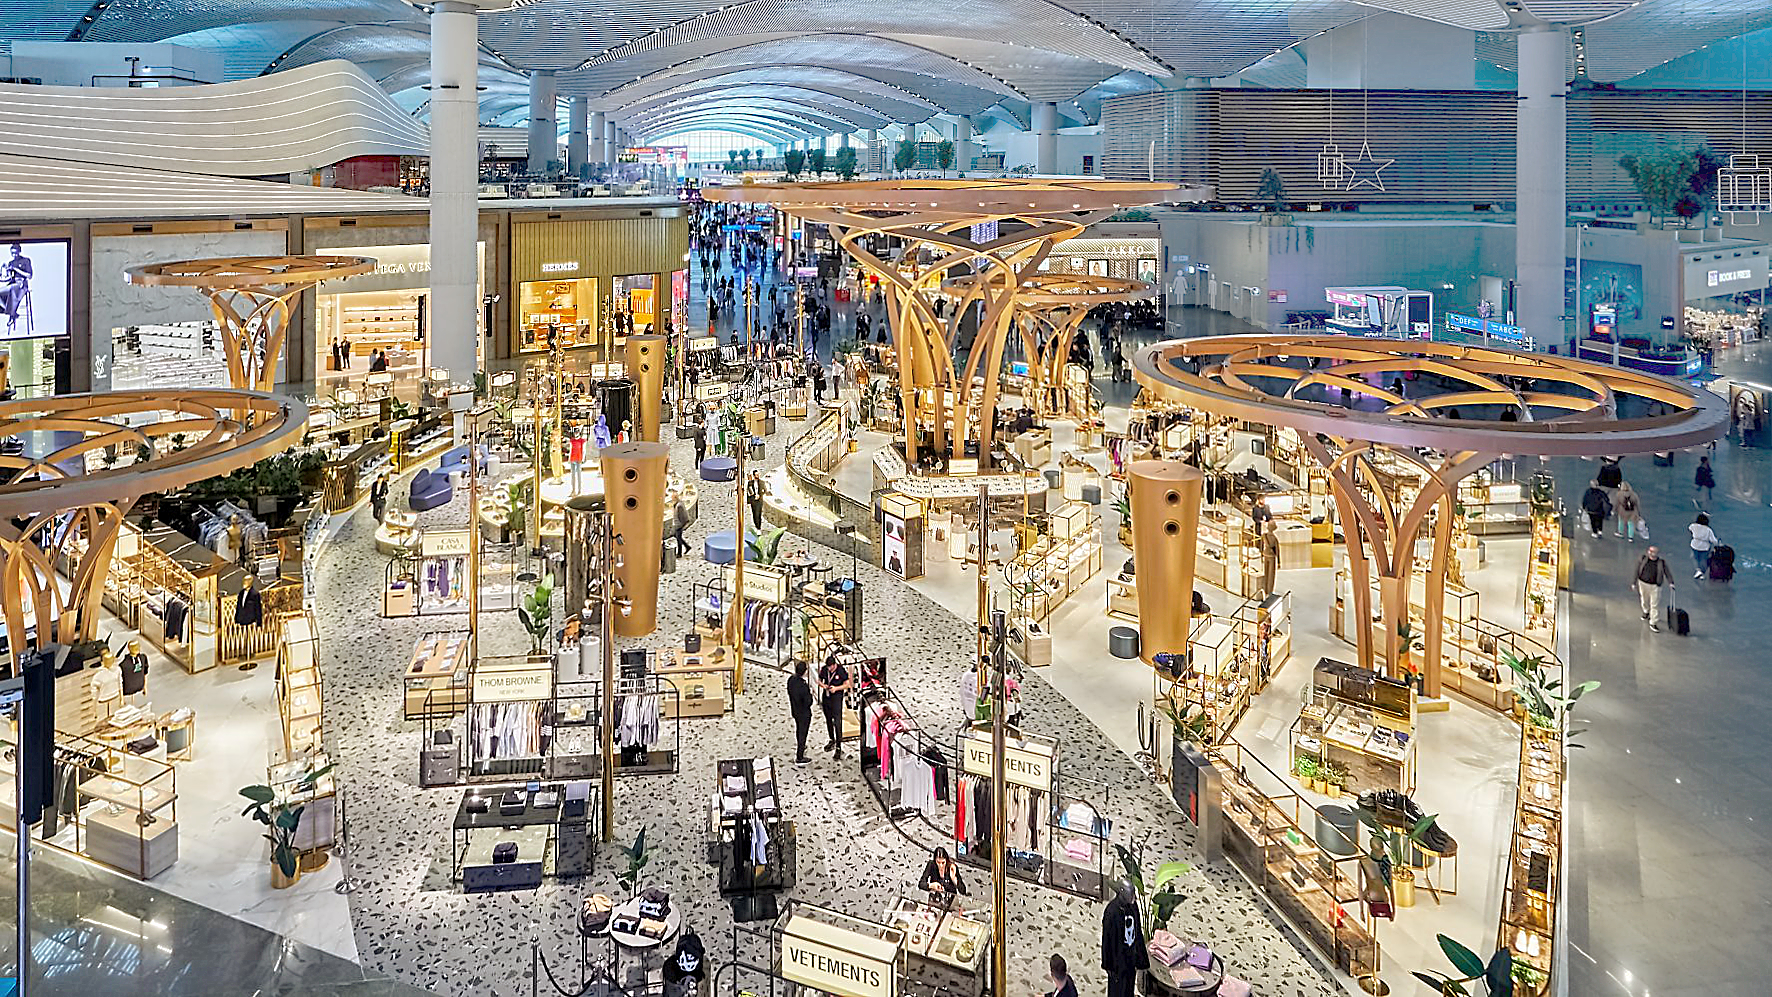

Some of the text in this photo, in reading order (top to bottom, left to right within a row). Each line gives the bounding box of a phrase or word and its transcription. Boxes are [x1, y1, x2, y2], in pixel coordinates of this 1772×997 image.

[1103, 245, 1145, 255] VAKKO
[408, 260, 432, 273] VEN
[440, 537, 460, 545] CASA
[436, 543, 465, 551] BLANCA
[749, 580, 773, 593] Studios
[479, 678, 504, 688] THOM
[969, 748, 1042, 777] VETENTS
[789, 945, 880, 988] VETEMENTS
